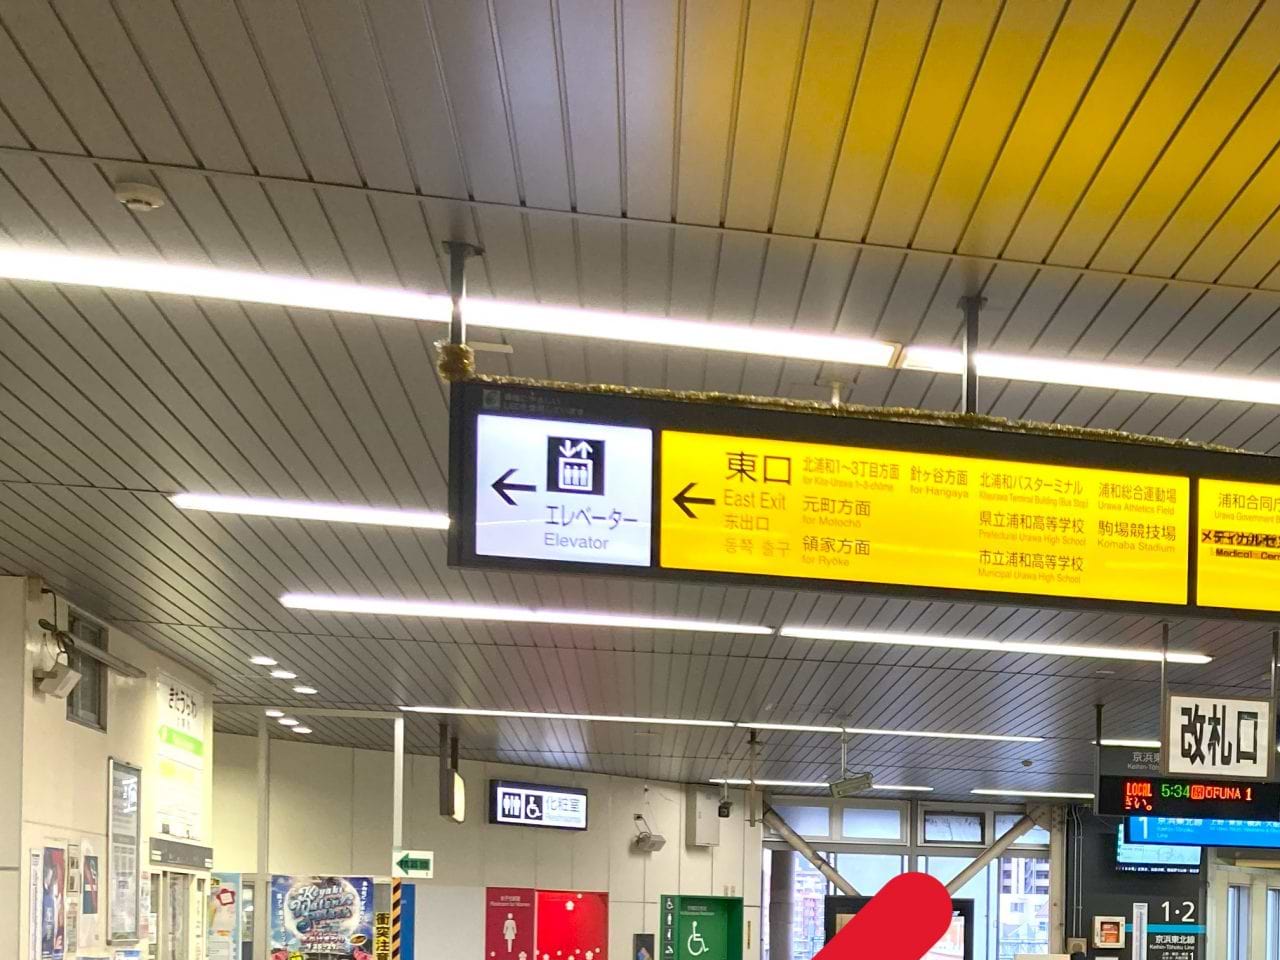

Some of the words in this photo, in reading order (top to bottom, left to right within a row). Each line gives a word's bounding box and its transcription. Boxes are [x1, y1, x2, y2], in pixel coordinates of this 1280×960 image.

[725, 451, 793, 485] 東口
[910, 485, 923, 495] for
[980, 472, 1084, 496] 北浦和バスターミナル
[1098, 481, 1177, 503] 浦和総合運動場
[724, 489, 755, 508] East
[760, 492, 787, 511] Exit
[803, 496, 872, 517] 元町方面
[1098, 501, 1121, 511] Urawa
[545, 504, 638, 530] エレベーター
[725, 514, 770, 531] 东出口
[802, 515, 816, 525] for
[979, 511, 1085, 534] 県立浦和高等学校
[1044, 534, 1060, 546] High
[1062, 536, 1087, 546] School
[1098, 520, 1176, 542] 駒場競技場
[544, 533, 609, 551] Elevator
[802, 535, 871, 556] 領家方面
[1098, 538, 1136, 550] Komaba
[1138, 542, 1176, 553] Stadium
[802, 555, 816, 564] for
[979, 549, 1084, 572] 市立浦和高等学校
[1037, 572, 1055, 583] High
[1056, 573, 1081, 584] School
[1181, 703, 1260, 766] 改札口
[1126, 782, 1152, 797] LOCAL
[1161, 783, 1190, 798] 5:34
[1245, 787, 1253, 800] 1
[1138, 817, 1149, 840] 1
